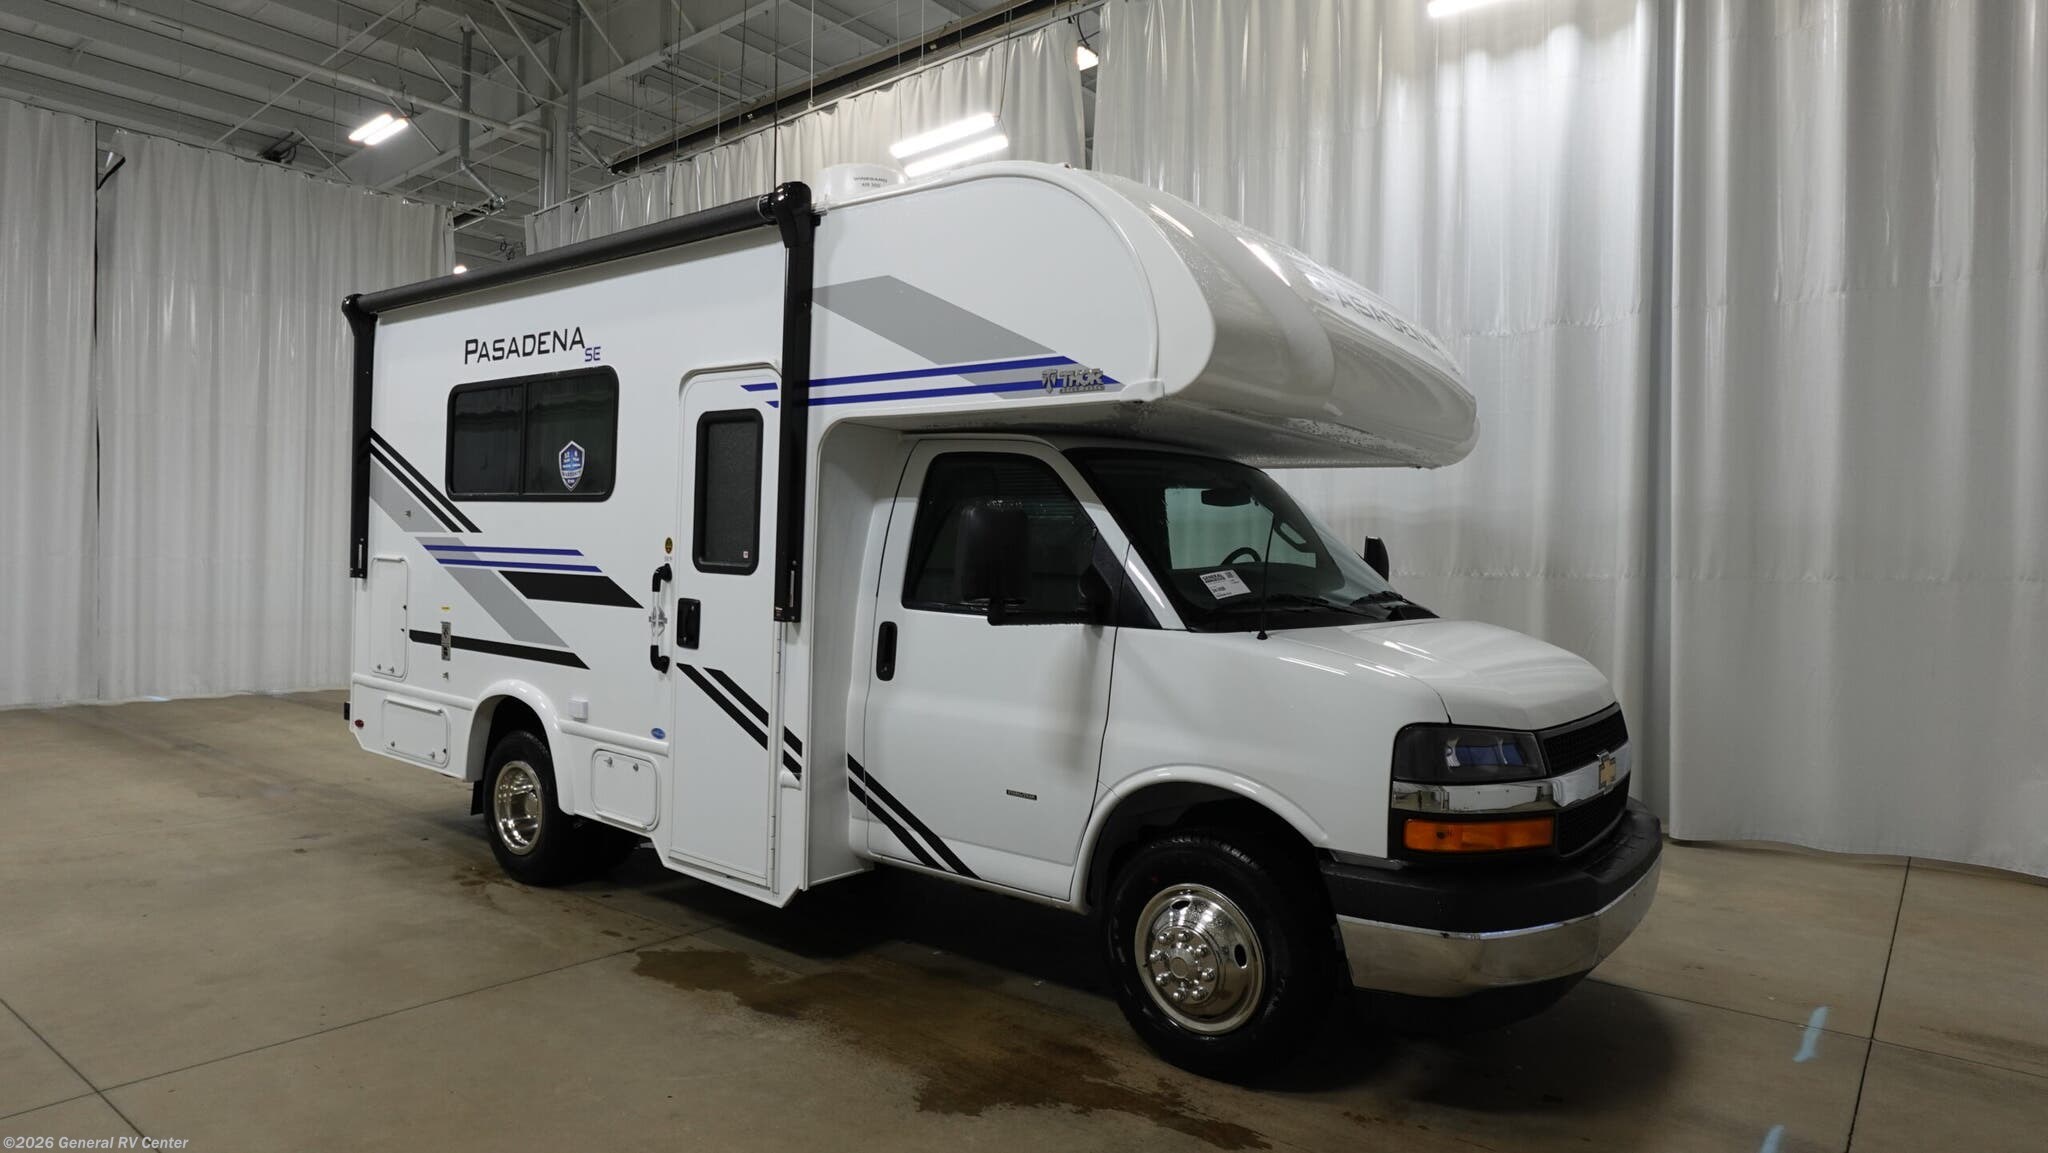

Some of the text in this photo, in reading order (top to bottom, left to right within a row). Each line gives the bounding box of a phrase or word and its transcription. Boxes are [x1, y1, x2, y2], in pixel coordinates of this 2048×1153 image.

[464, 326, 602, 365] PASADENA SE
[1059, 368, 1105, 388] THOR
